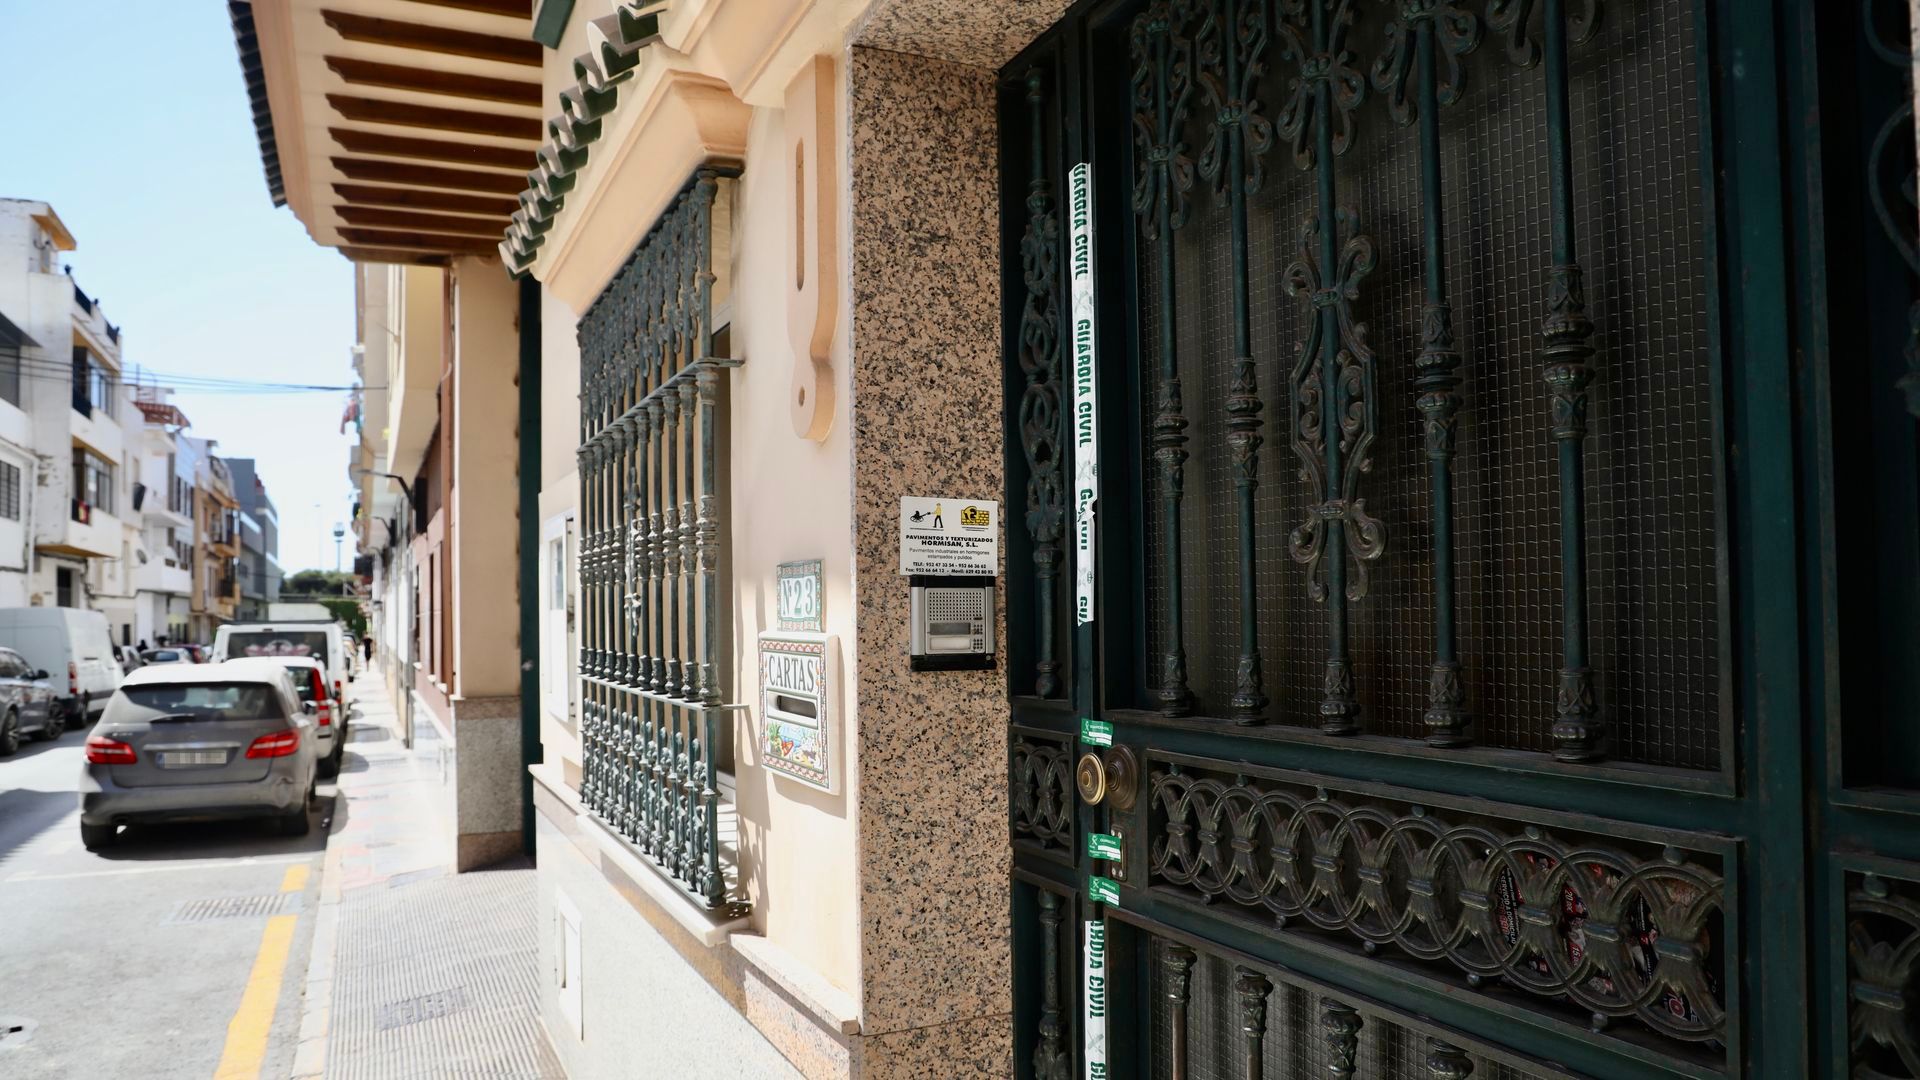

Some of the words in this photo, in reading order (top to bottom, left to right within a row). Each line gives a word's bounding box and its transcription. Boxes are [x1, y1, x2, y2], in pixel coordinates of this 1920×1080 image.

[1074, 234, 1089, 281] CIVIL
[1077, 318, 1092, 398] GUARDIA
[1079, 401, 1093, 448] CIVIL
[921, 540, 964, 548] HORMISAN,
[794, 577, 813, 615] 23
[768, 654, 815, 693] CARTAS
[1506, 911, 1516, 945] DOMICILIO
[1089, 975, 1105, 1019] CIVIL
